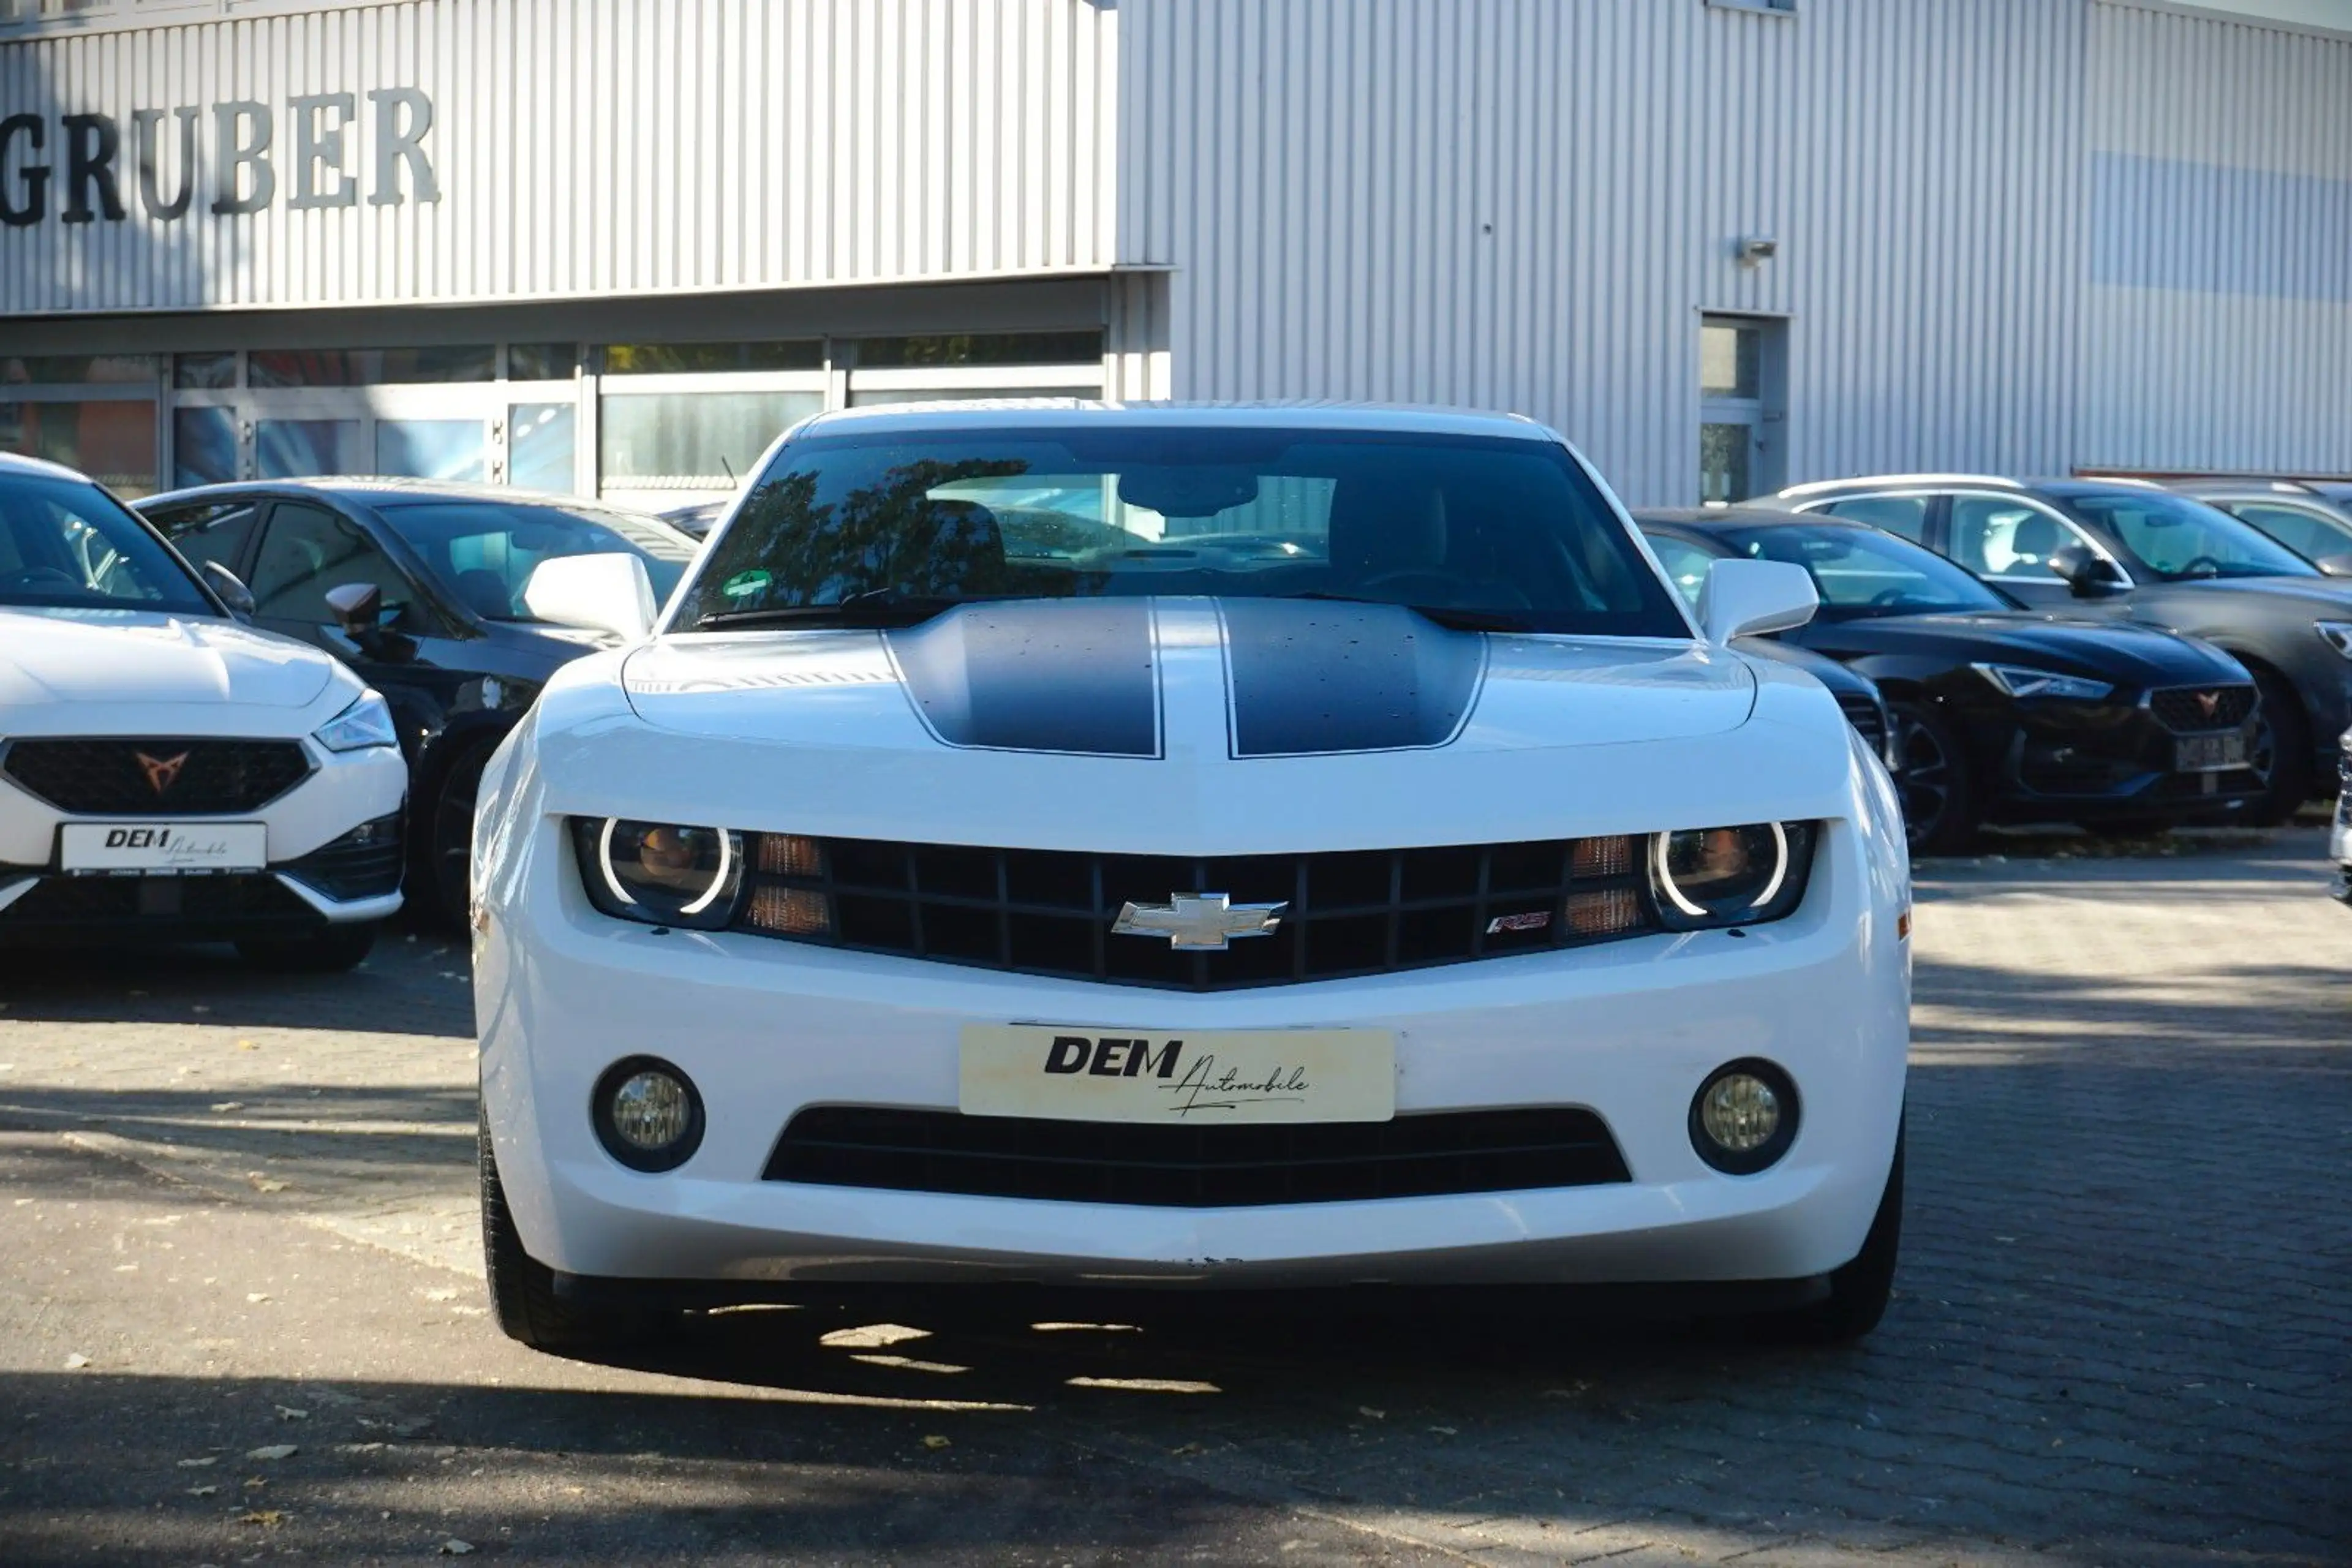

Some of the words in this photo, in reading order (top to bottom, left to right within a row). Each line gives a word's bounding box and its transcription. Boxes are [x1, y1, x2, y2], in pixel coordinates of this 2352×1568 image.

[0, 87, 442, 226] GRUBER
[105, 829, 171, 848] DEM
[1044, 1036, 1183, 1078] DEM
[1158, 1055, 1310, 1117] Automobile
